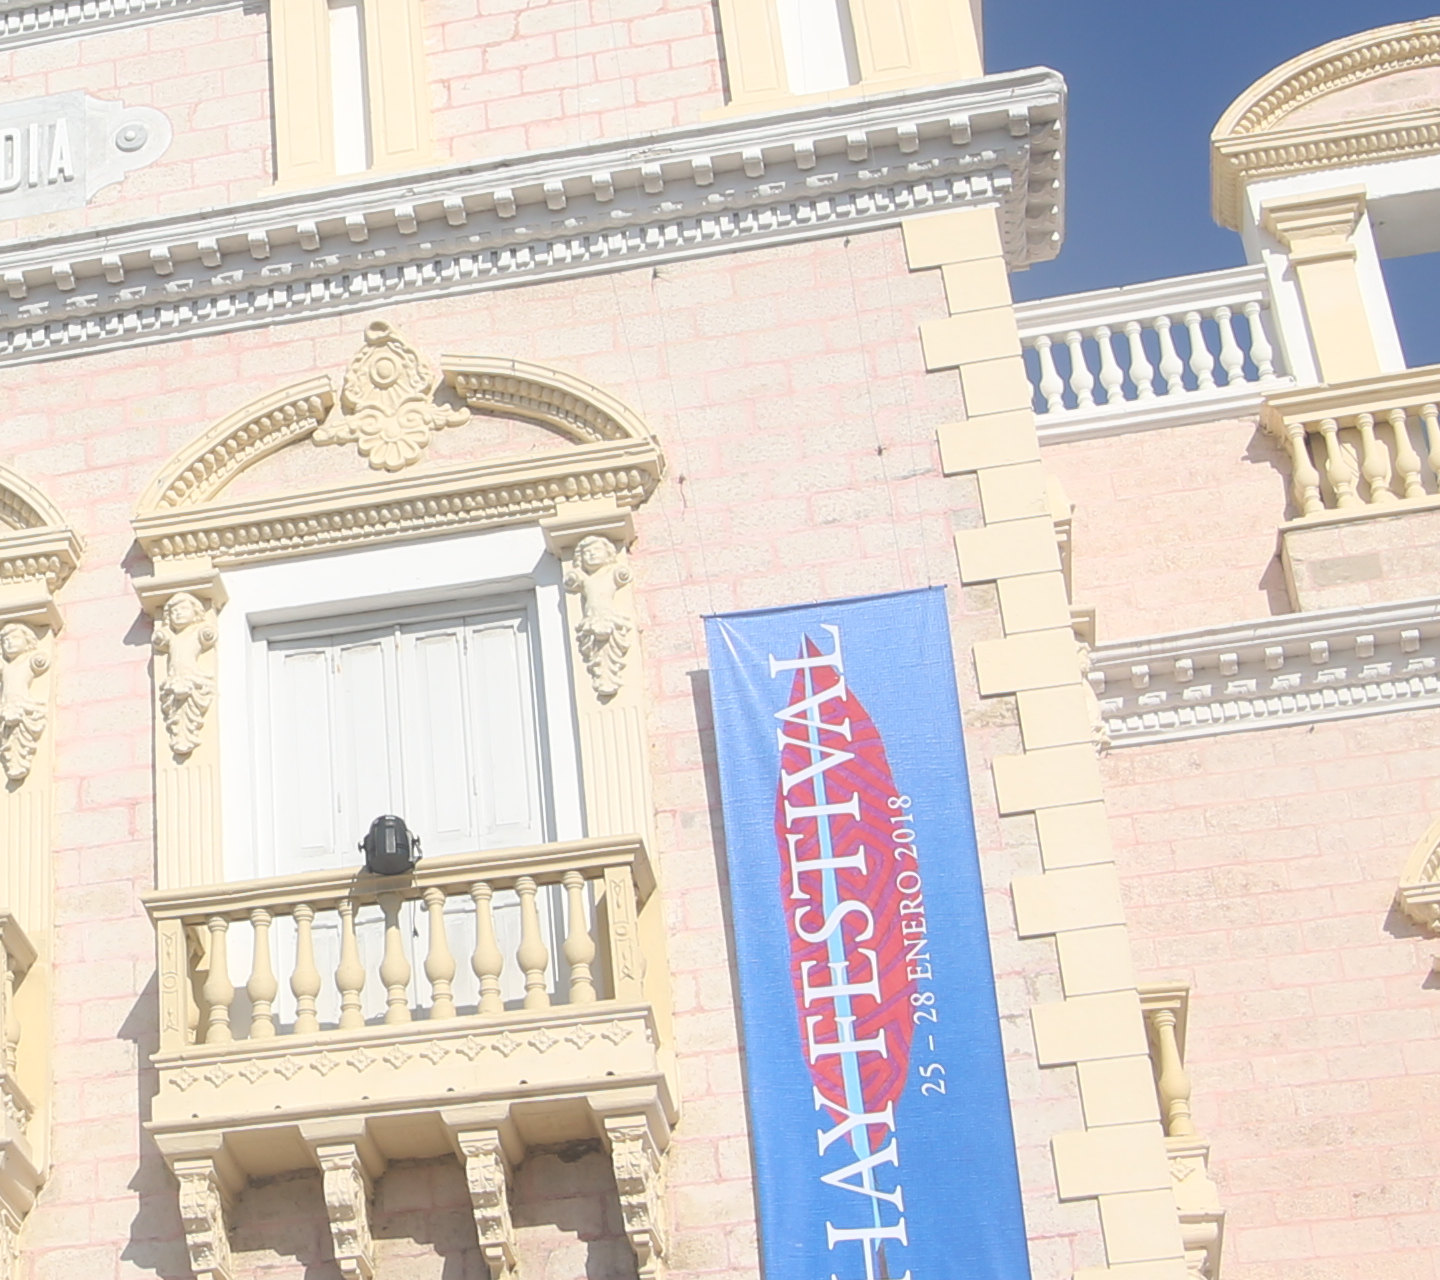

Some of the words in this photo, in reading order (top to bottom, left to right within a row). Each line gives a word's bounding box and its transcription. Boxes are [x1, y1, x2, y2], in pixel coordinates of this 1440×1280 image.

[768, 623, 890, 1066] FESTIVAL
[888, 794, 919, 861] 2018
[896, 870, 933, 981] ENERO
[910, 991, 938, 1025] 28
[919, 1063, 947, 1097] 25
